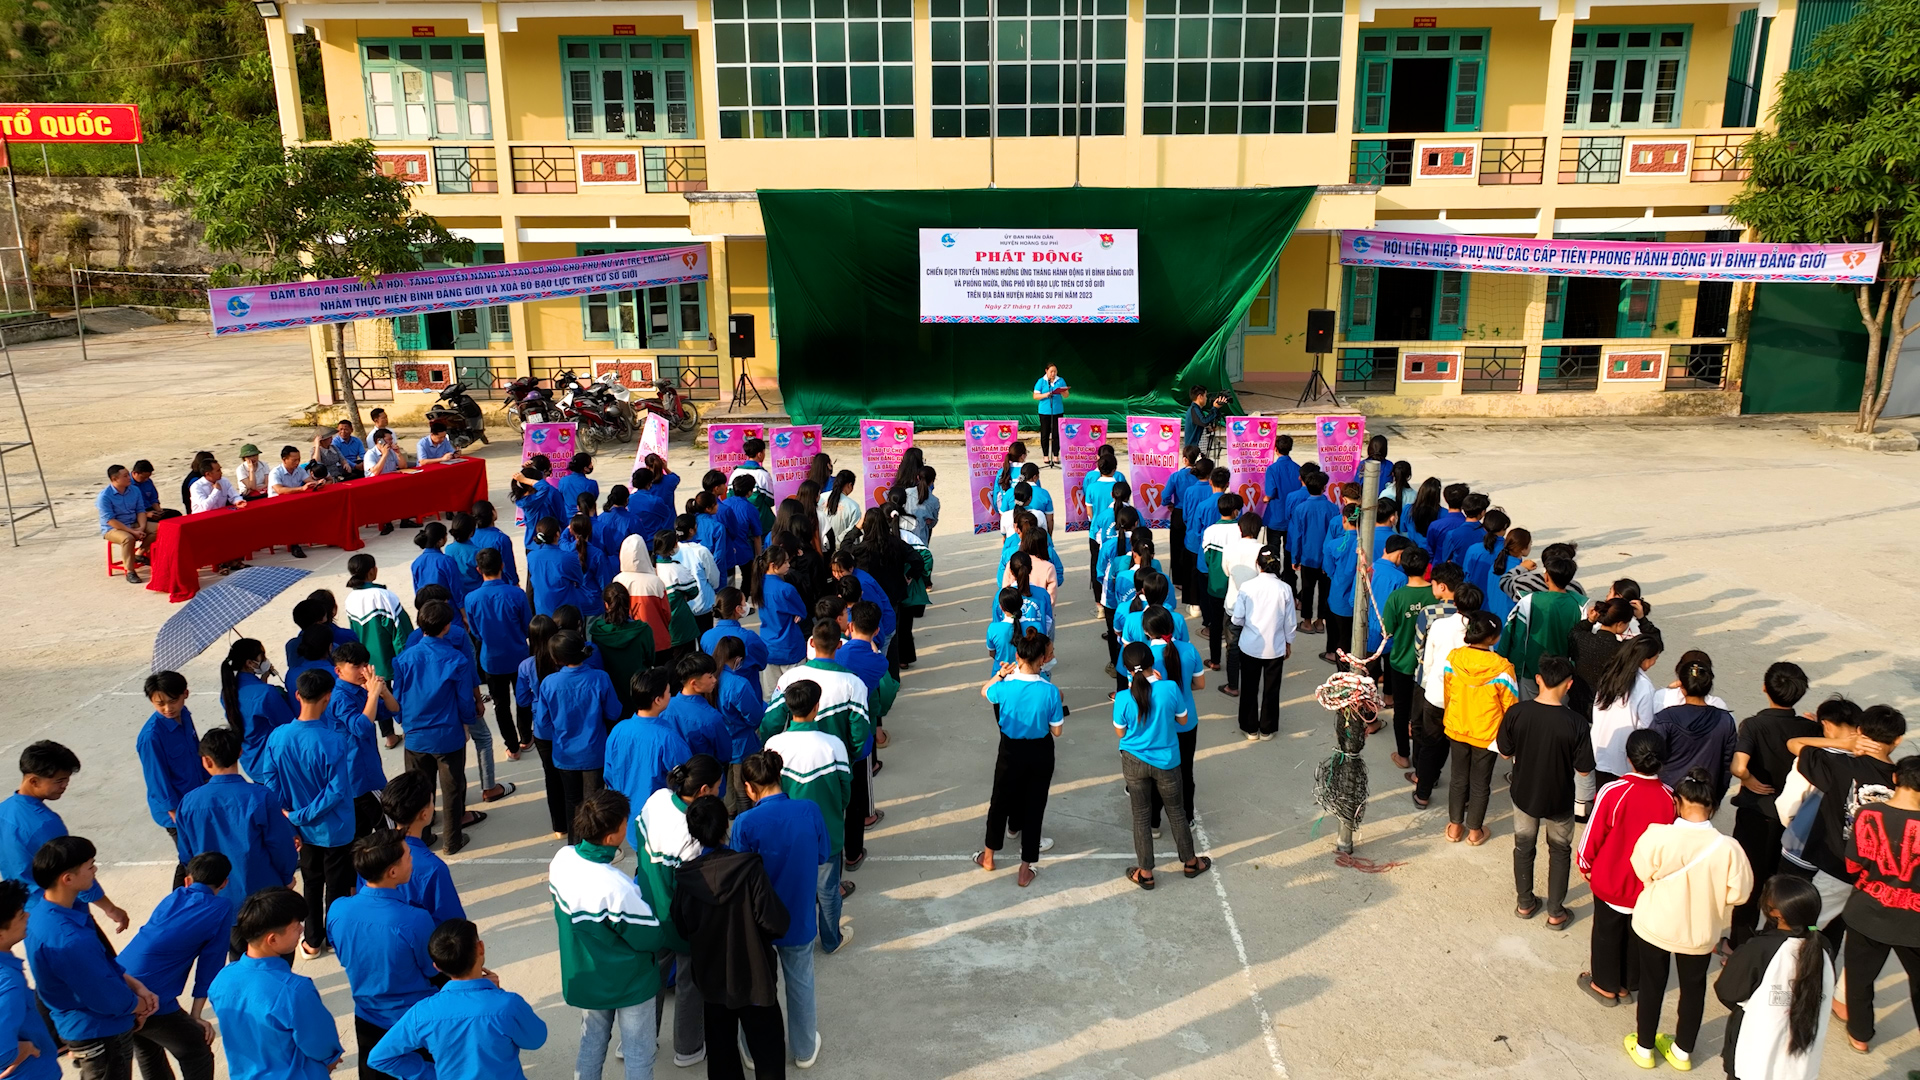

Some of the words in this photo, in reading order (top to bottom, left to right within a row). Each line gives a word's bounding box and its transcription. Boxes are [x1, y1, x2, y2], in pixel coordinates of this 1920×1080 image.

[0, 108, 32, 136] TỔ
[39, 109, 112, 138] QUỐC
[976, 249, 1025, 262] PHÁT
[1032, 250, 1083, 264] ĐỘNG
[1383, 239, 1401, 258] HỘI
[1405, 239, 1430, 256] LIÊN
[1432, 240, 1458, 260] HIỆP
[1461, 244, 1484, 262] PHỤ
[1488, 242, 1505, 260] NỮ
[1508, 244, 1530, 262] CÁC
[1534, 243, 1557, 262] CẤP
[1561, 246, 1587, 264] TIÊN
[1590, 250, 1630, 266] PHONG
[1634, 248, 1668, 266] HÀNH
[1672, 250, 1707, 270] ĐỘNG
[1710, 250, 1723, 267] VÌ
[1726, 250, 1756, 268] BÌNH
[1760, 246, 1796, 268] ĐẲNG
[1800, 250, 1827, 268] GIỚI
[270, 287, 296, 300] ĐẢM
[299, 284, 320, 297] BẢO
[324, 286, 338, 294] AN
[371, 281, 384, 290] XÃ
[386, 278, 406, 290] HỘI,
[409, 276, 434, 286] TĂNG
[437, 272, 468, 284] QUYỀN
[471, 270, 497, 280] NĂNG
[499, 268, 511, 277] VÀ
[513, 268, 530, 278] TẠO
[532, 266, 544, 274] CƠ
[546, 264, 560, 274] HỘI
[563, 262, 580, 272] CHO
[582, 260, 599, 270] PHỤ
[601, 258, 613, 268] NỮ
[615, 257, 625, 266] VÀ
[627, 254, 641, 265] TRẺ
[926, 266, 943, 276] CHIẾN
[944, 268, 958, 277] DỊCH
[959, 266, 980, 276] TRUYỀN
[981, 268, 999, 276] THÔNG
[1000, 266, 1019, 276] HƯỞNG
[1020, 266, 1032, 276] ỨNG
[1033, 267, 1051, 276] THÁNG
[1052, 267, 1068, 276] HÀNH
[1068, 267, 1084, 277] ĐỘNG
[1092, 268, 1106, 276] BÌNH
[1106, 266, 1122, 276] ĐẲNG
[1122, 267, 1134, 276] GIỚI
[320, 298, 352, 311] NHẰM
[355, 296, 381, 308] THỰC
[384, 293, 407, 305] HIỆN
[410, 290, 433, 301] BÌNH
[436, 286, 462, 298] ĐẲNG
[465, 284, 484, 296] GIỚI
[486, 283, 498, 293] VÀ
[500, 281, 518, 292] XOÁ
[521, 279, 532, 290] BỎ
[535, 279, 552, 290] BẠO
[554, 276, 570, 288] LỰC
[573, 274, 594, 285] TRÊN
[596, 272, 607, 282] CƠ
[609, 270, 620, 280] SỞ
[622, 269, 638, 279] GIỚI
[962, 279, 982, 287] PHÒNG
[1000, 279, 1012, 287] ỨNG
[1014, 279, 1025, 287] PHÓ
[1036, 280, 1048, 289] BẠO
[1049, 280, 1060, 289] LỰC
[1061, 279, 1075, 287] TRÊN
[1085, 278, 1093, 287] SỞ
[967, 290, 982, 298] TRÊN
[982, 291, 992, 300] ĐỊA
[993, 290, 1005, 298] BÀN
[1006, 290, 1024, 300] HUYỆN
[1026, 290, 1044, 298] HOÀNG
[1065, 290, 1078, 298] NĂM
[1145, 448, 1161, 467] ĐẲNG
[1162, 452, 1175, 468] GIỚI
